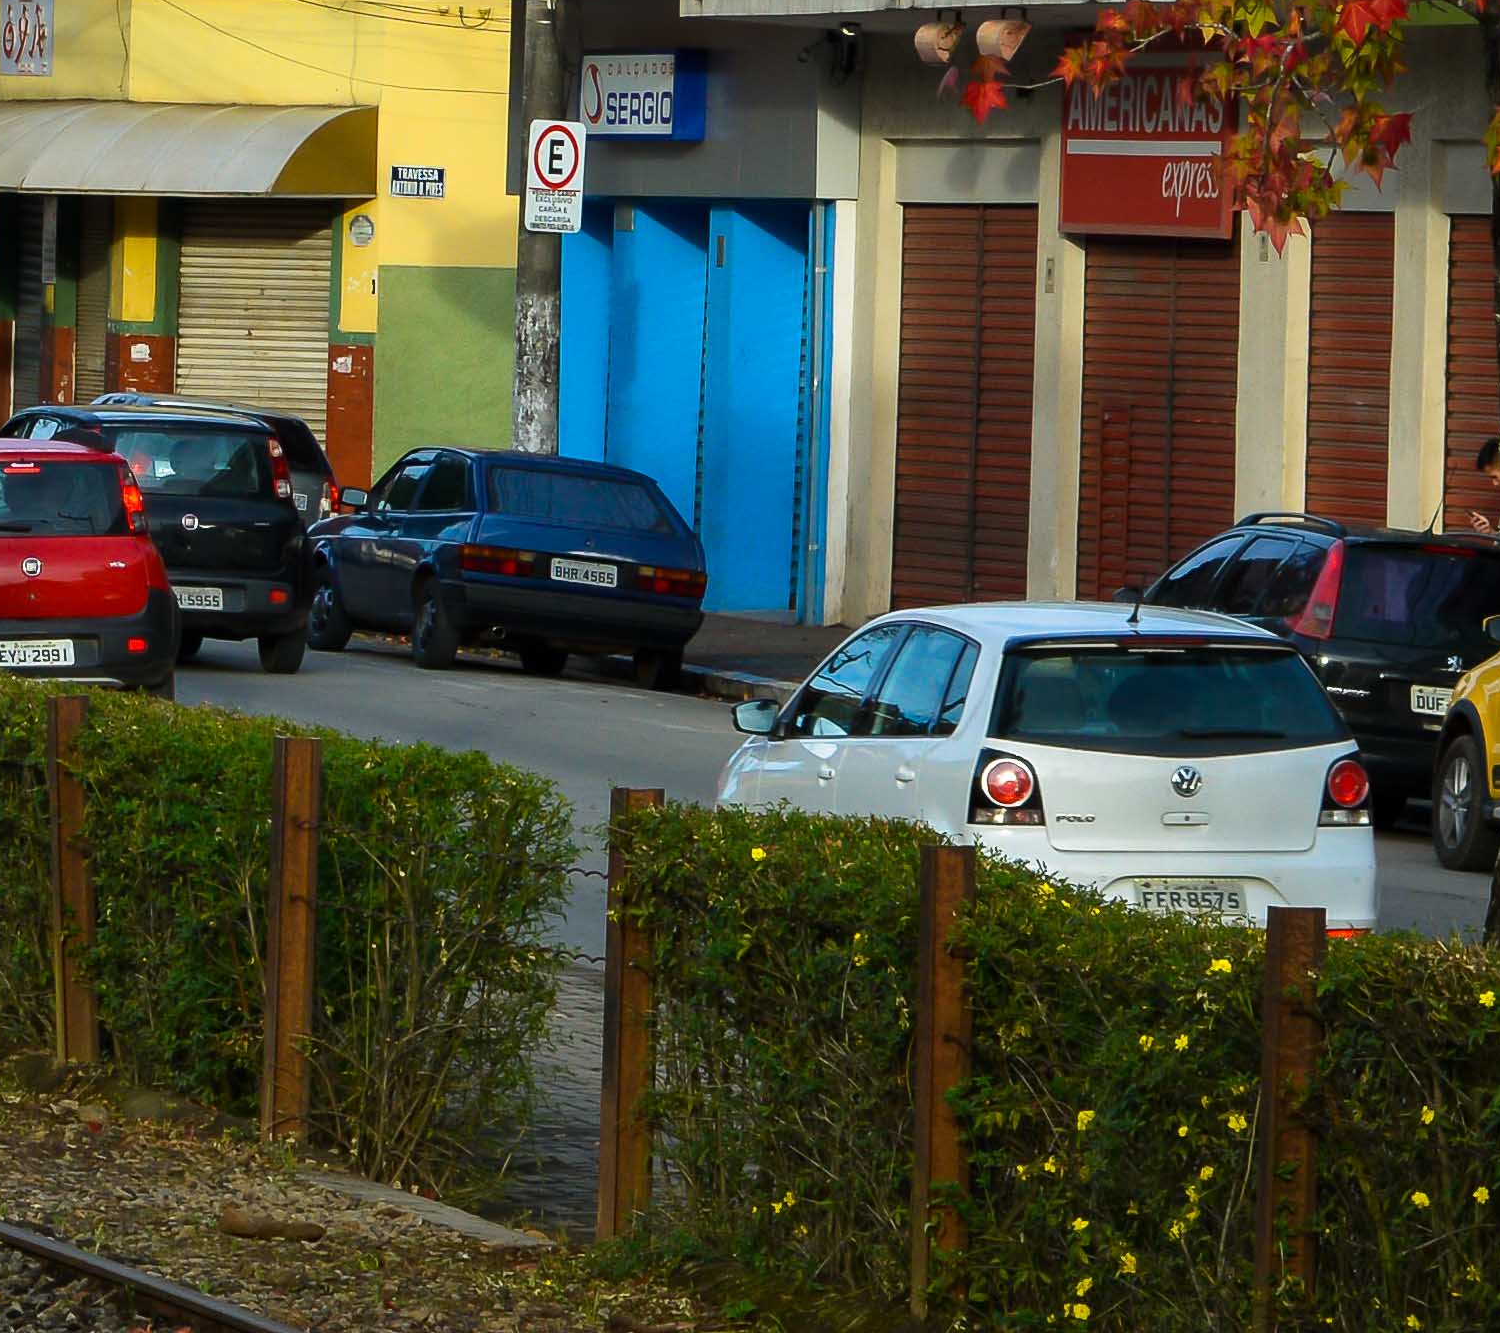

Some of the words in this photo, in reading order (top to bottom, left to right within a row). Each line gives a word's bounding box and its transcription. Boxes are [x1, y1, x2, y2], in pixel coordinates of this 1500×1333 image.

[606, 91, 672, 126] SERGIO
[1067, 75, 1223, 134] AMERICANAS
[397, 167, 439, 181] TRAVESSA
[548, 138, 565, 176] E
[1055, 813, 1097, 823] POLO
